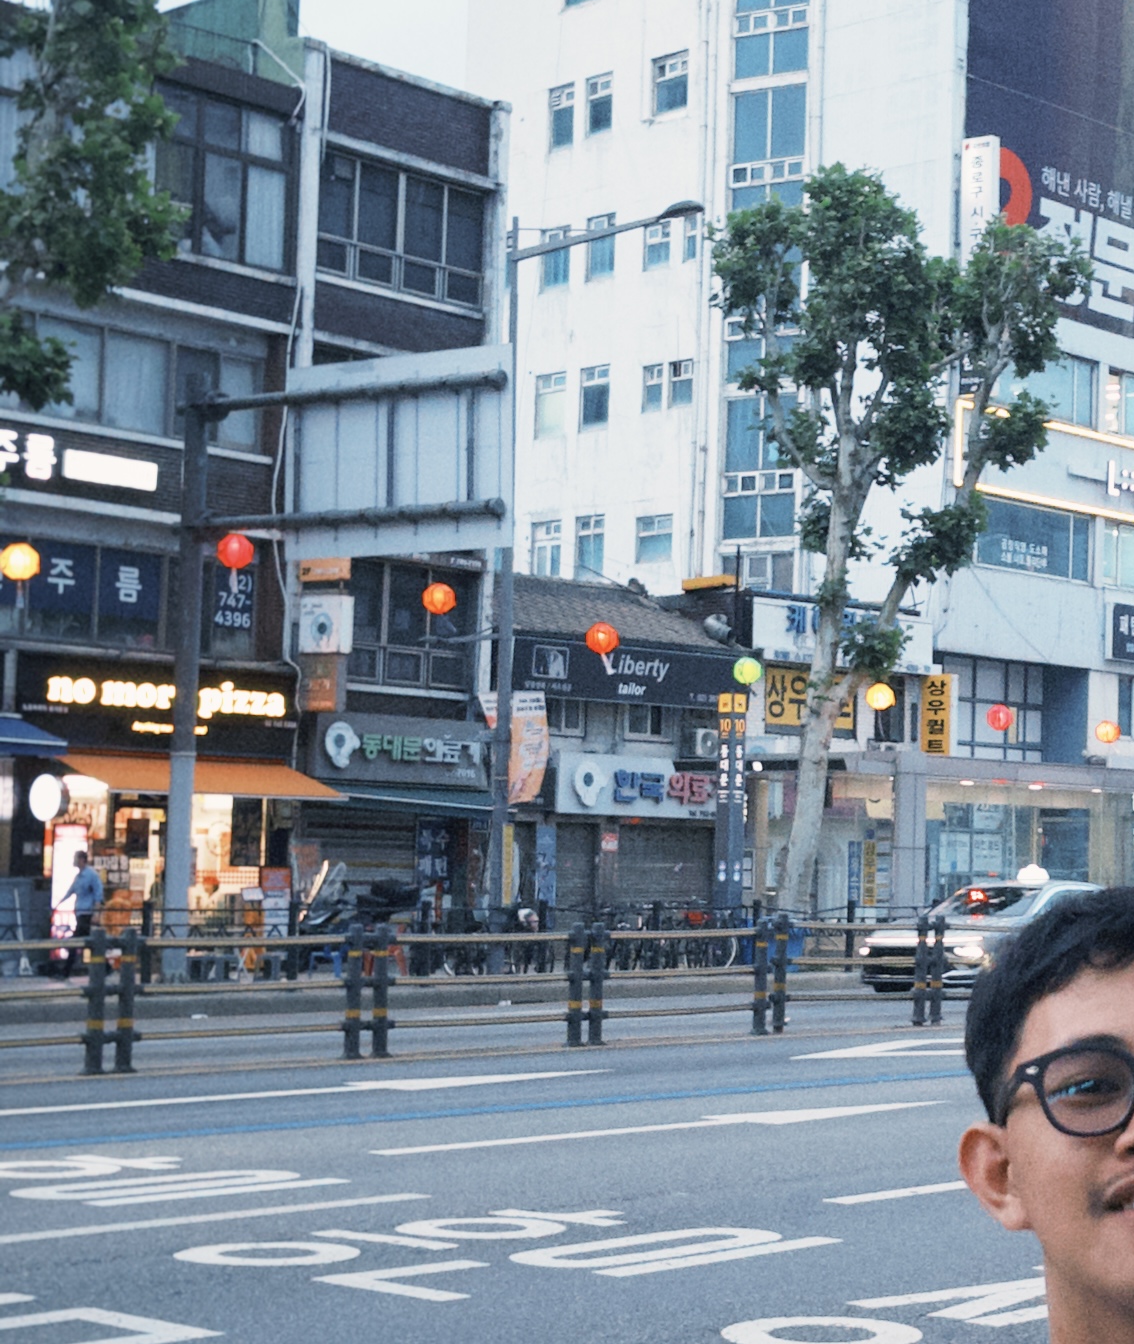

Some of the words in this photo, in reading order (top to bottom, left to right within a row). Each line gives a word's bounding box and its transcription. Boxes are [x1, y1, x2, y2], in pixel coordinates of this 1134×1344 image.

[1040, 165, 1071, 198] 해낸
[213, 610, 251, 629] 4396
[608, 652, 671, 683] Liberty
[46, 675, 98, 705] no
[100, 679, 177, 711] mor
[197, 679, 287, 720] pizza
[617, 682, 647, 697] tailor
[614, 768, 718, 806] 한국의료
